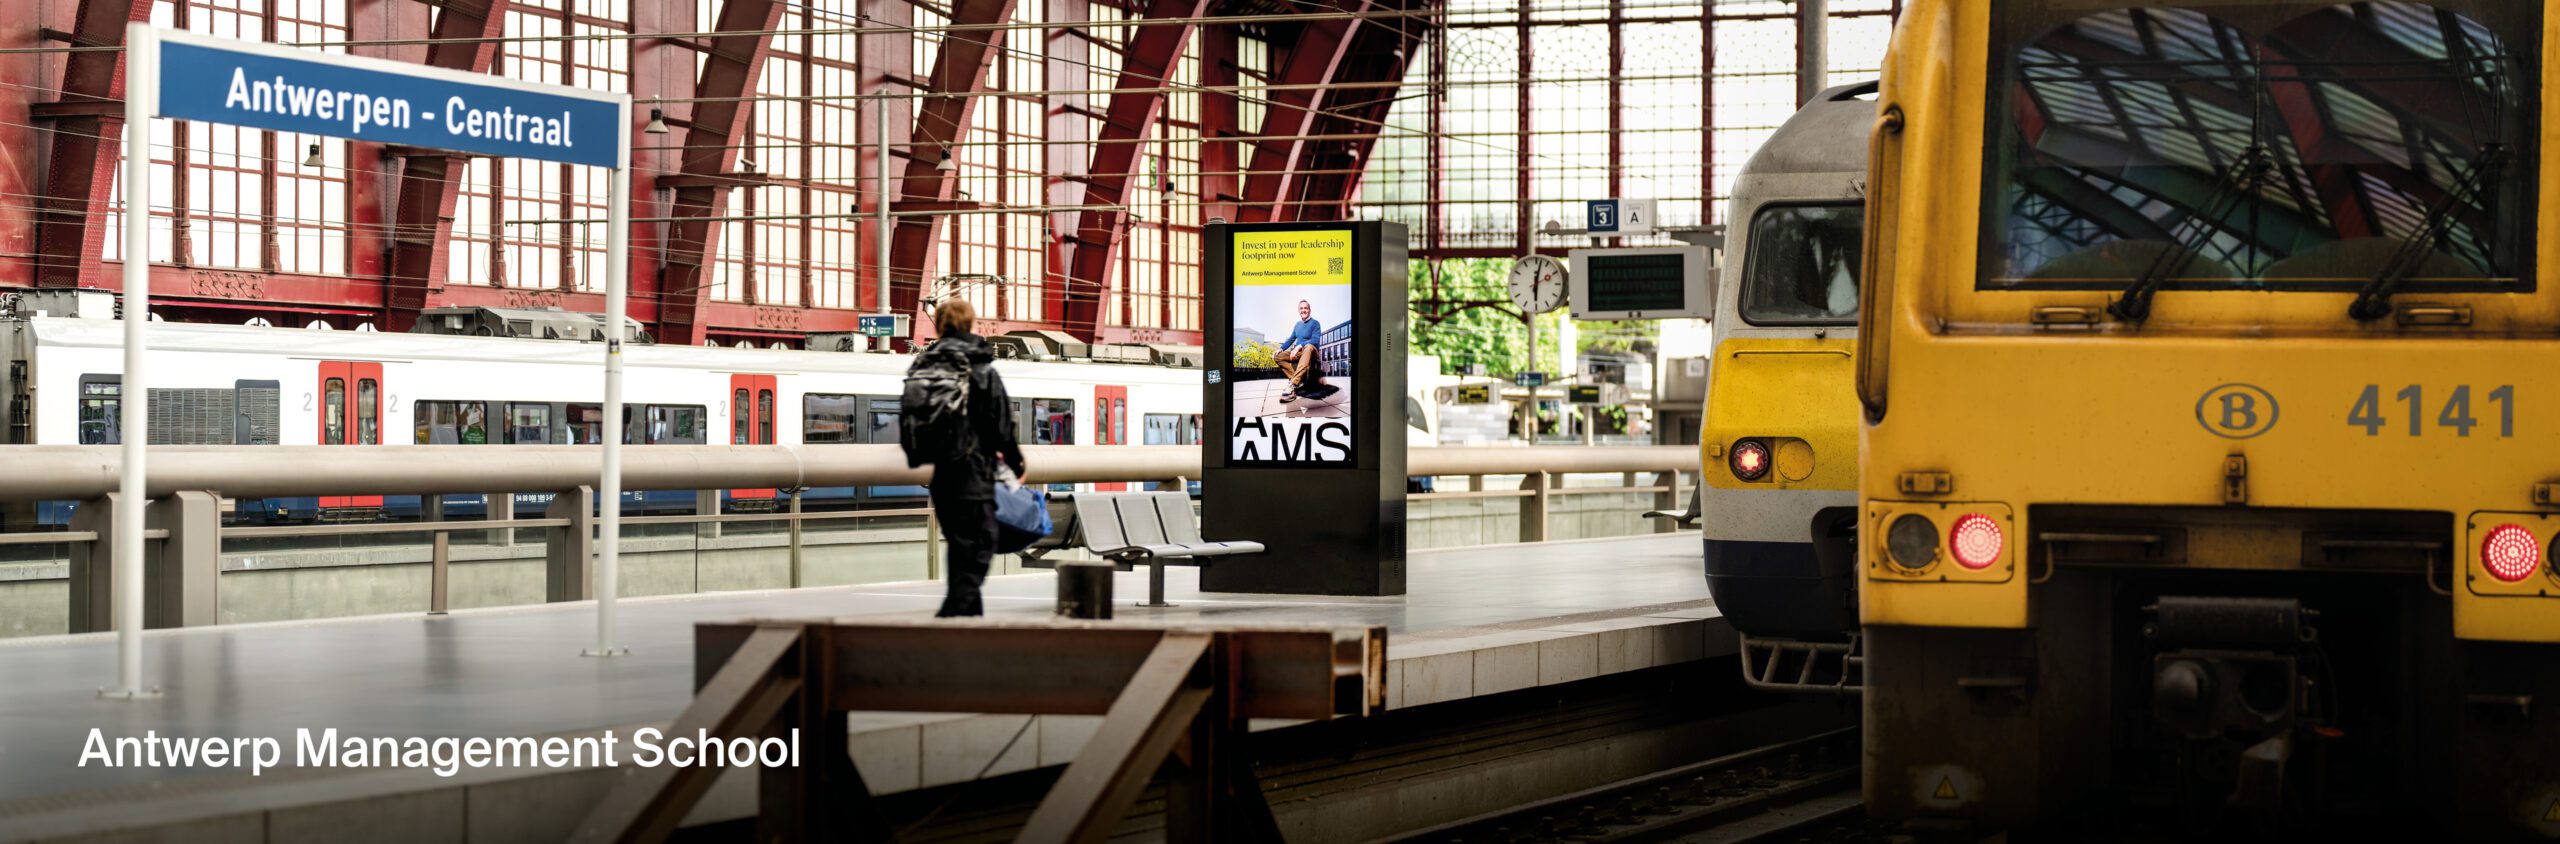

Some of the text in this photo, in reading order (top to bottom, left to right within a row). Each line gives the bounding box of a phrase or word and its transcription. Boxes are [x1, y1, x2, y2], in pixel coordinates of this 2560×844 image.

[225, 66, 410, 133] Antwerpen
[446, 96, 573, 147] Centraal
[1599, 212, 1607, 224] 3
[1630, 211, 1639, 223] A
[1242, 239, 1345, 251] Invest in your leadership
[1242, 250, 1277, 261] footprint
[303, 392, 312, 412] 2
[389, 394, 398, 413] 2
[720, 400, 726, 417] 2
[2219, 392, 2258, 430] B
[2347, 384, 2514, 438] 4141
